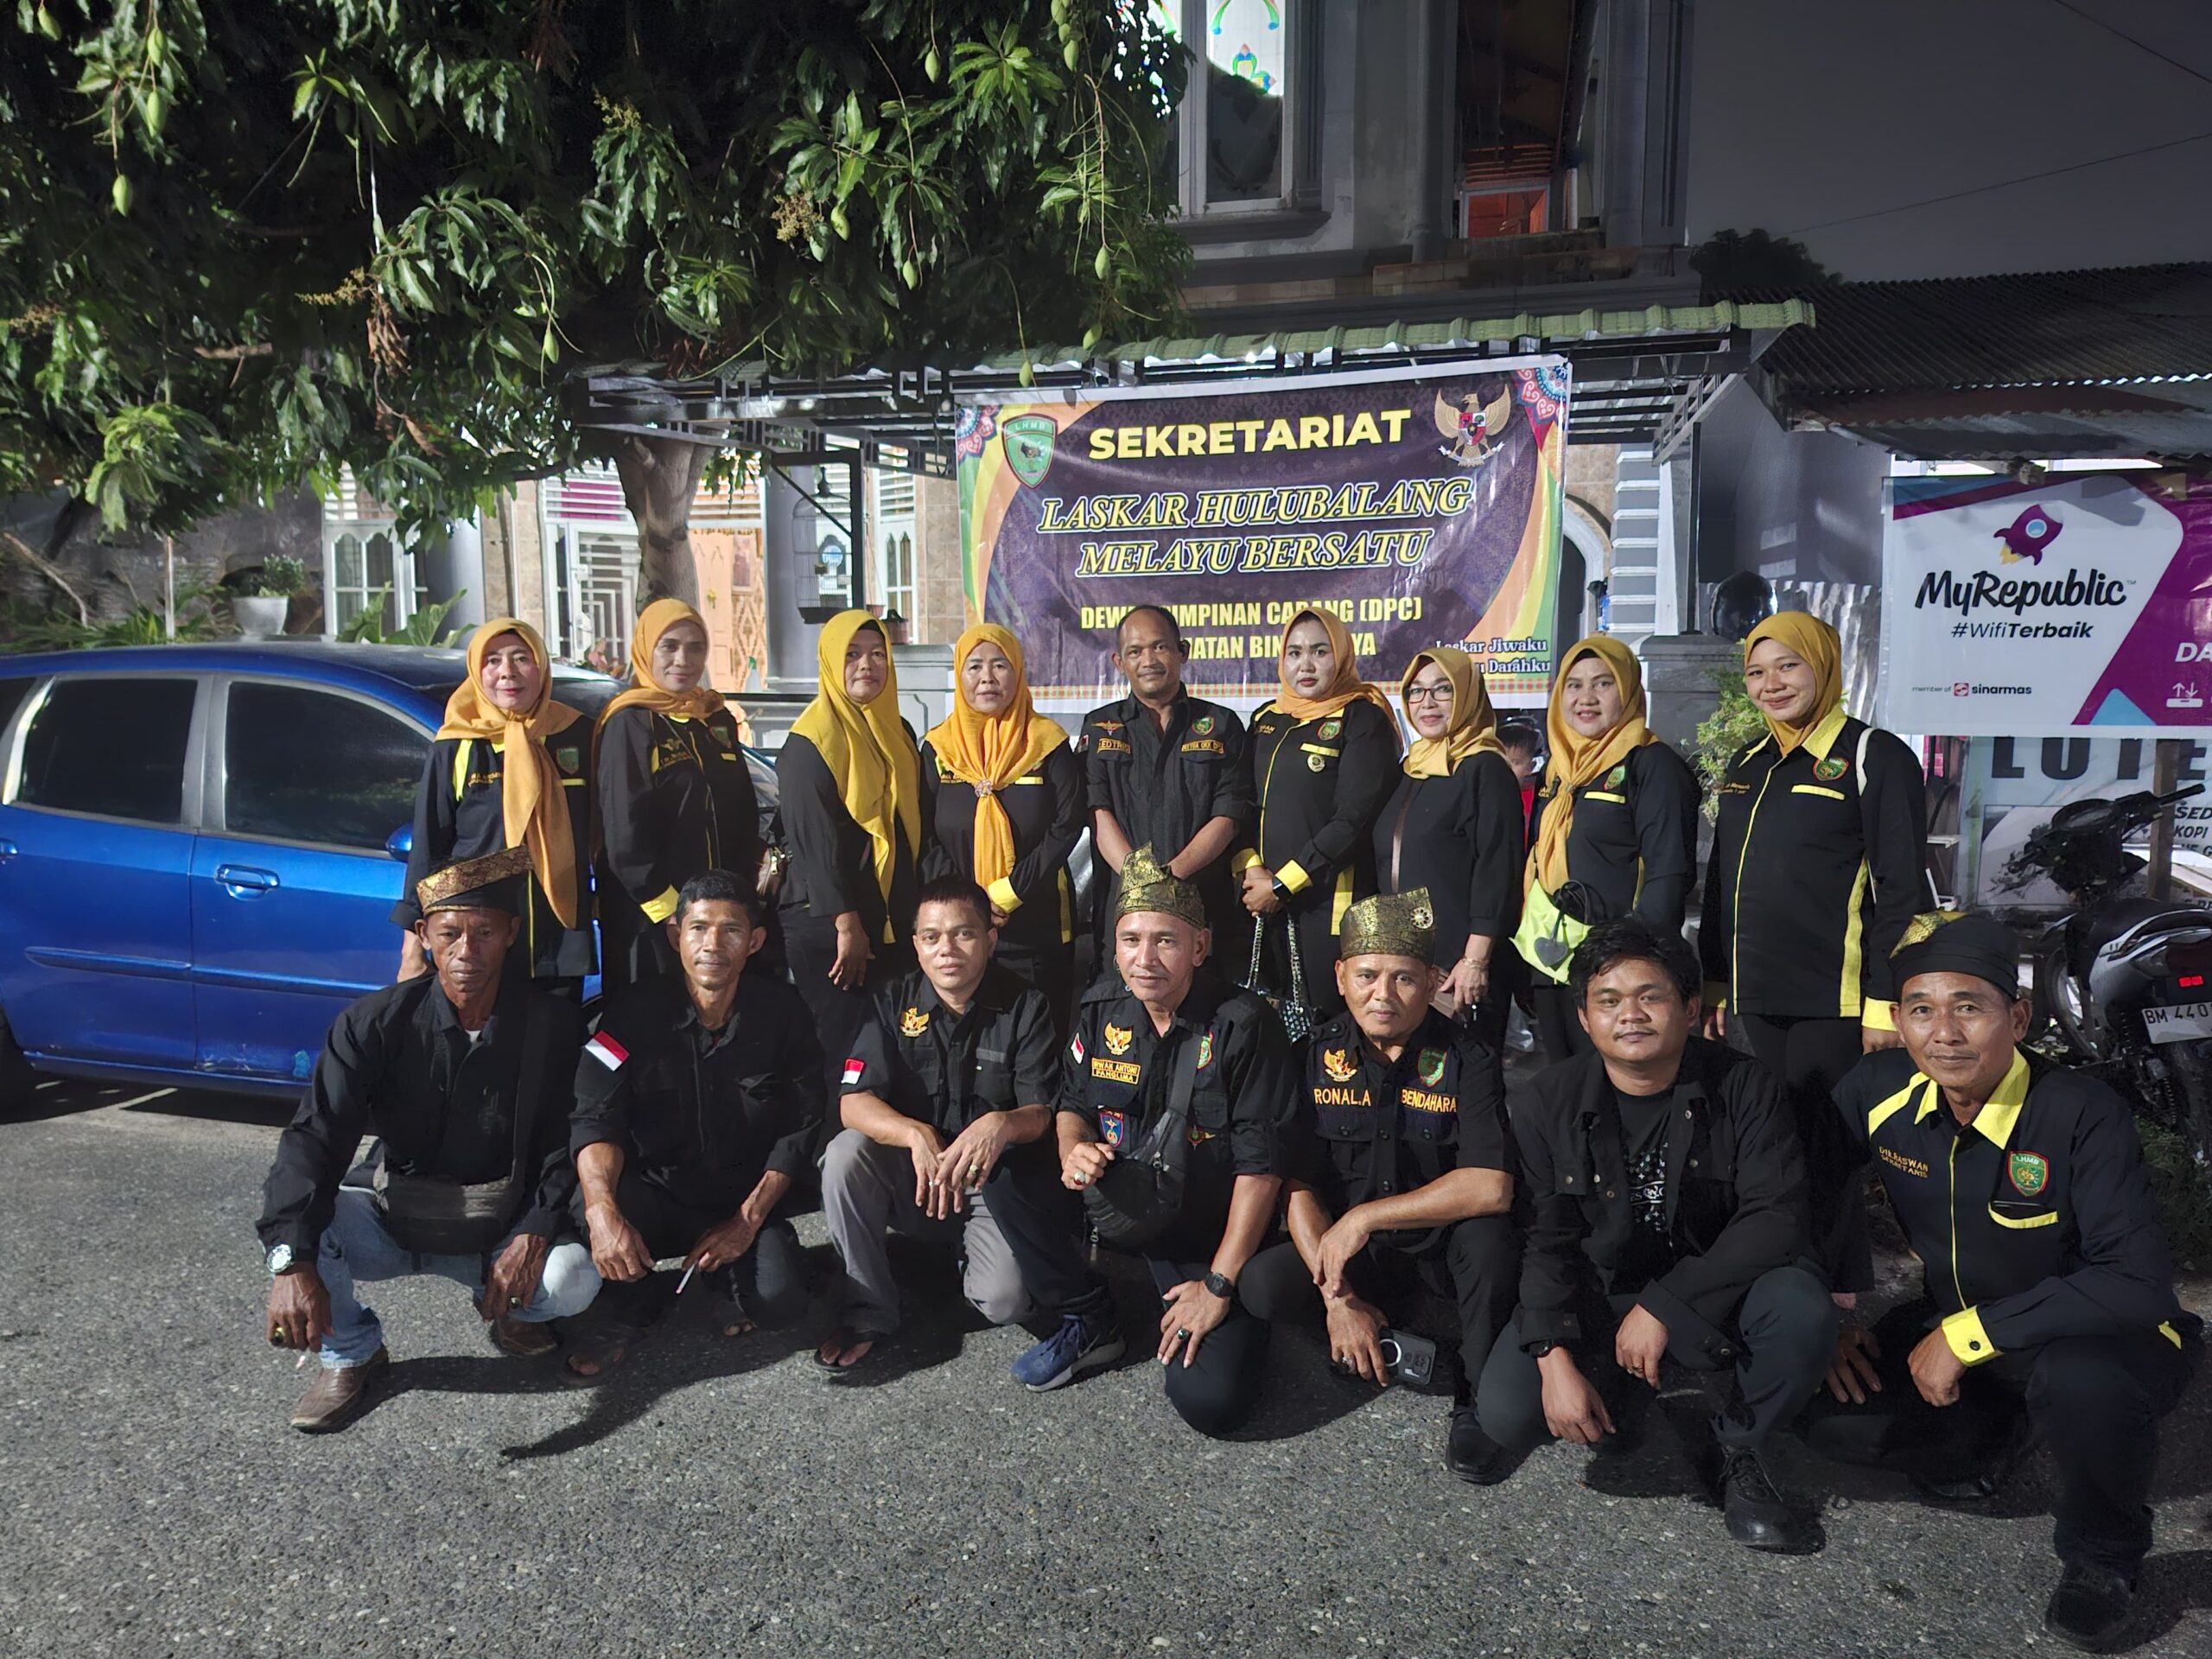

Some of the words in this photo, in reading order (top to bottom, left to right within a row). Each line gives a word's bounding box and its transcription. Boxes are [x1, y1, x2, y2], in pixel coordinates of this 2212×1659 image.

[1089, 410, 1412, 460] SEKRETARIAT
[1037, 491, 1188, 533] LASKAR
[1192, 478, 1472, 525] HULUBALANG
[1076, 537, 1240, 578] MELAYU
[1241, 529, 1434, 570] BERSATU
[1915, 569, 2127, 617] MyRepublic
[1081, 606, 1136, 629] DEW
[1160, 602, 1261, 628] IMPINAN
[1360, 597, 1422, 622] (DPC)
[1951, 622, 2094, 639] #WifiTerbaik
[1489, 638, 1548, 653] Jiwaku
[1489, 658, 1551, 673] Darahku
[1972, 683, 2032, 695] sinarmas
[2174, 826, 2209, 838] KOPI
[2145, 1008, 2169, 1024] BM
[2175, 1004, 2212, 1020] 440
[1401, 1089, 1457, 1113] BENDAHARA
